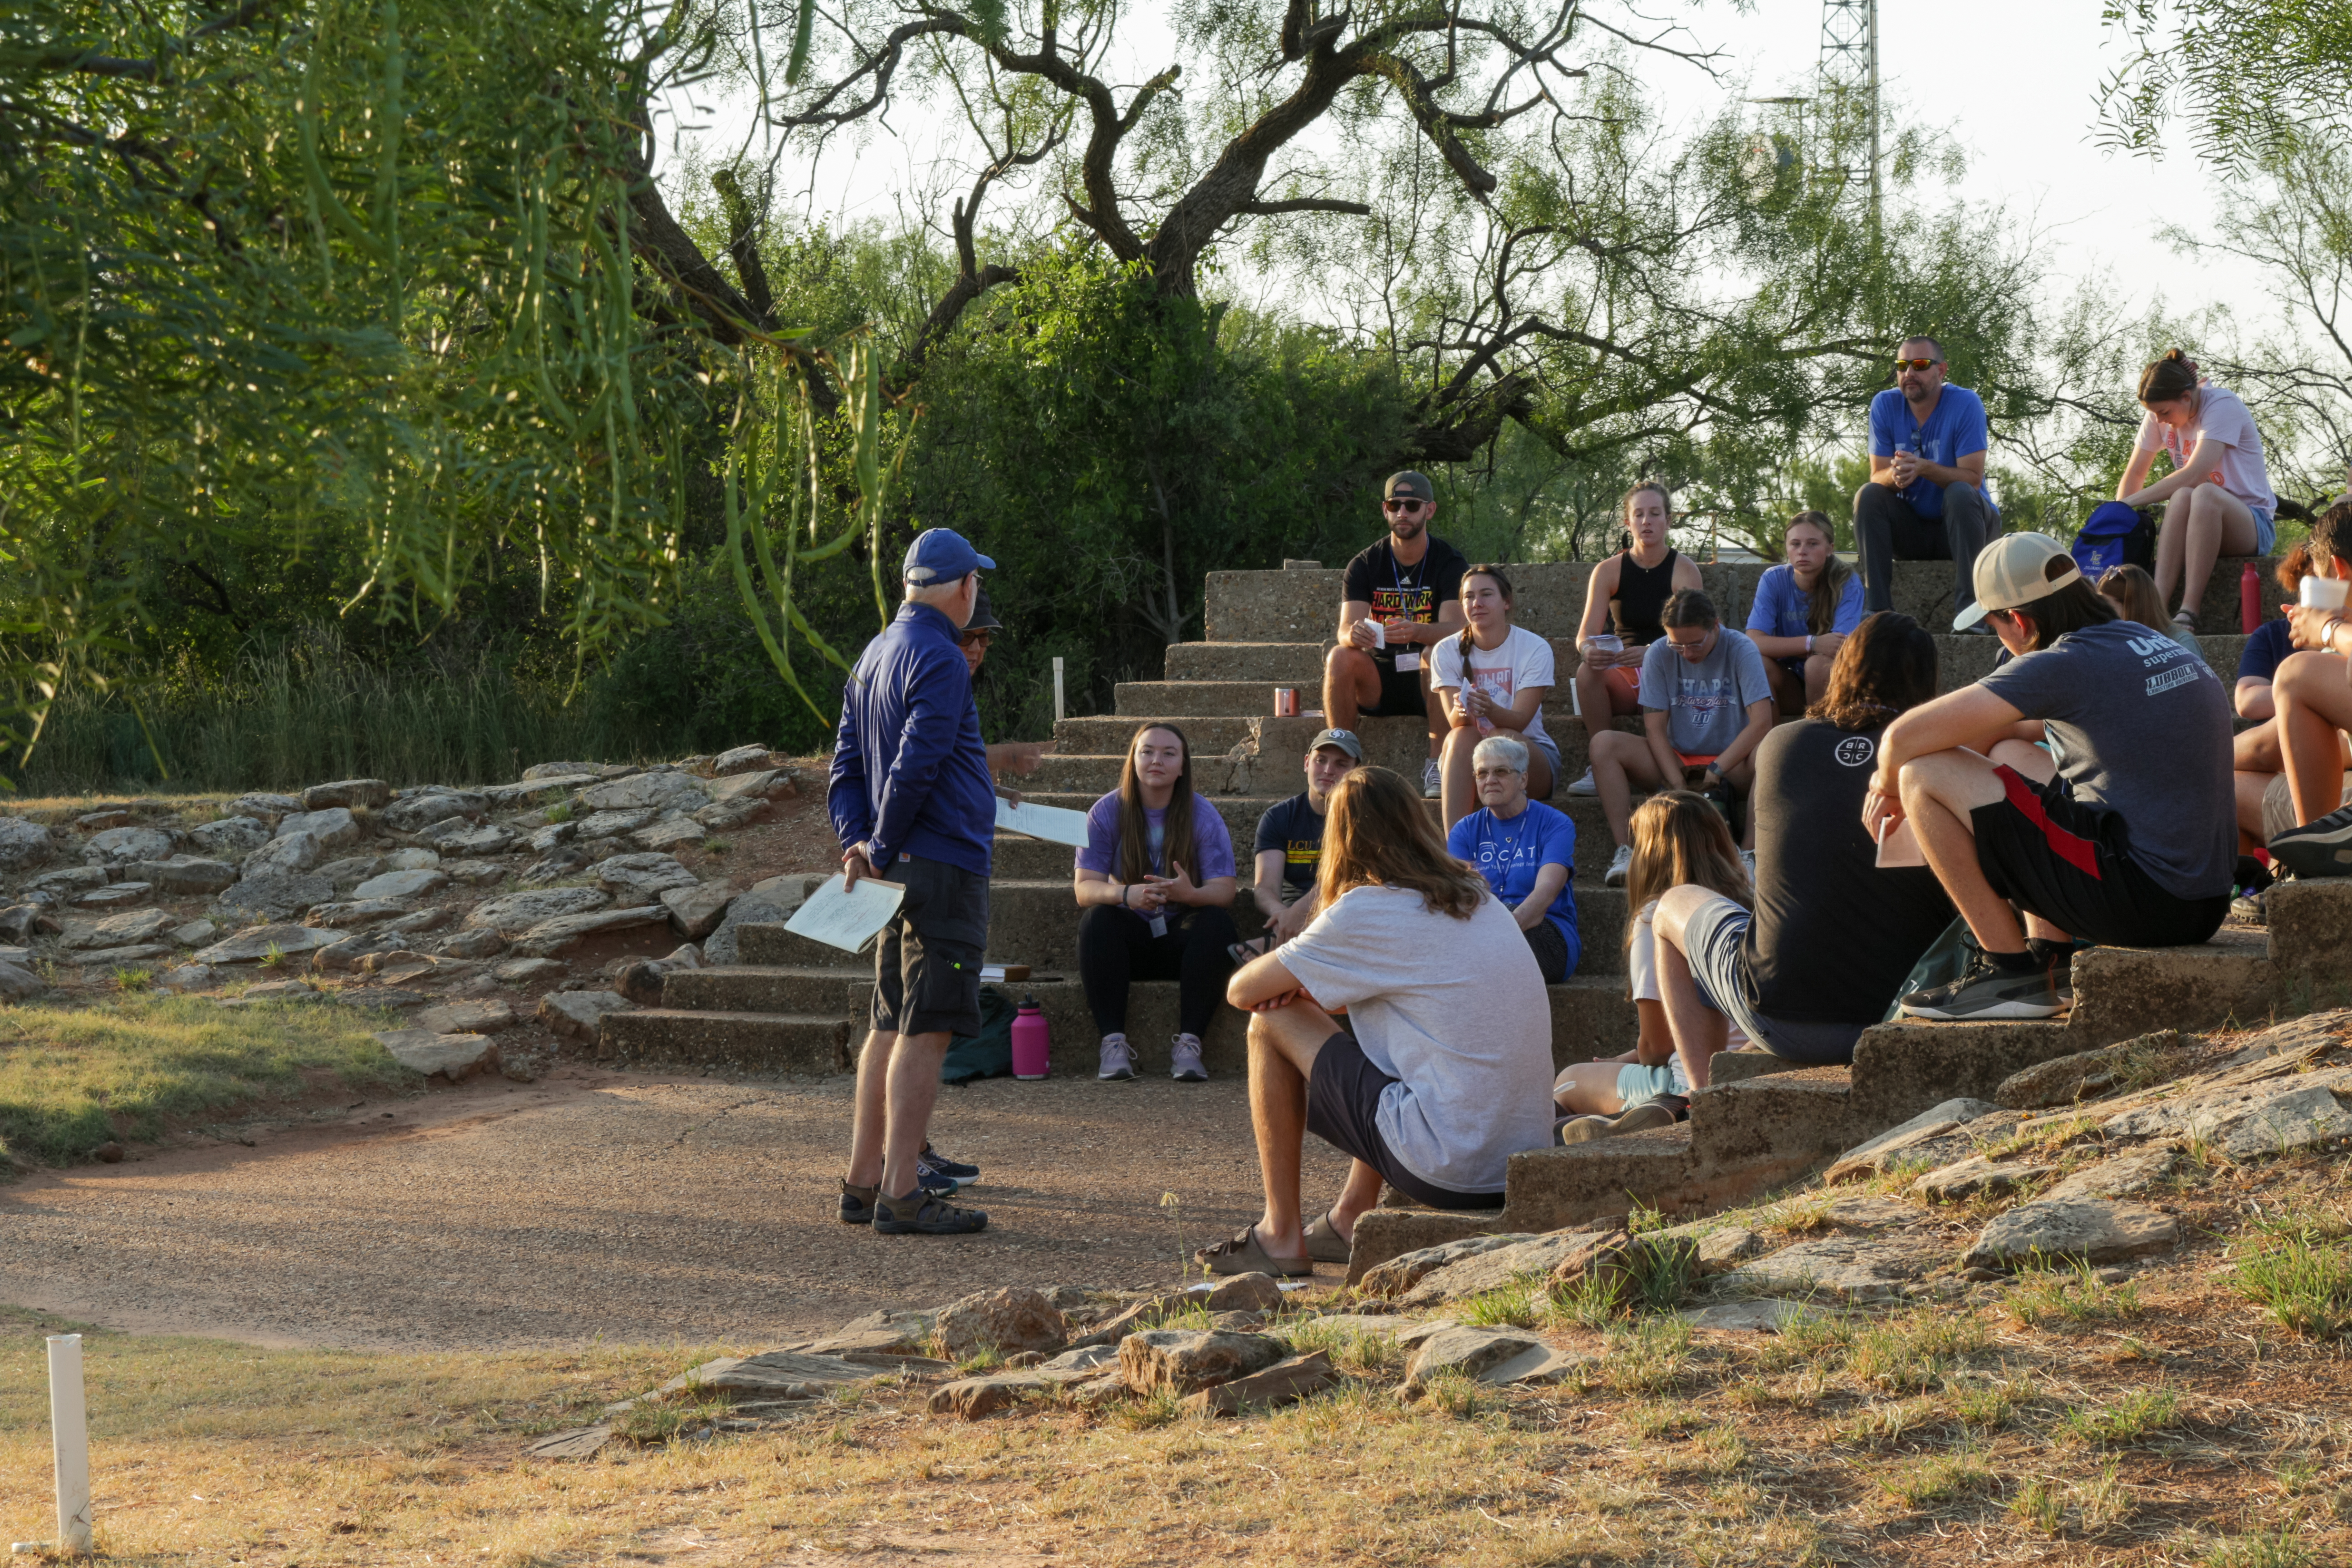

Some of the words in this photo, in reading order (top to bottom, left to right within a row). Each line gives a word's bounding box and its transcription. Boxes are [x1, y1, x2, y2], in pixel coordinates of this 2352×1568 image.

[2148, 665, 2196, 689] LUBBOCK
[2149, 683, 2174, 695] CHRISTIAN
[1677, 695, 1706, 707] Fture
[1287, 840, 1313, 851] LCU
